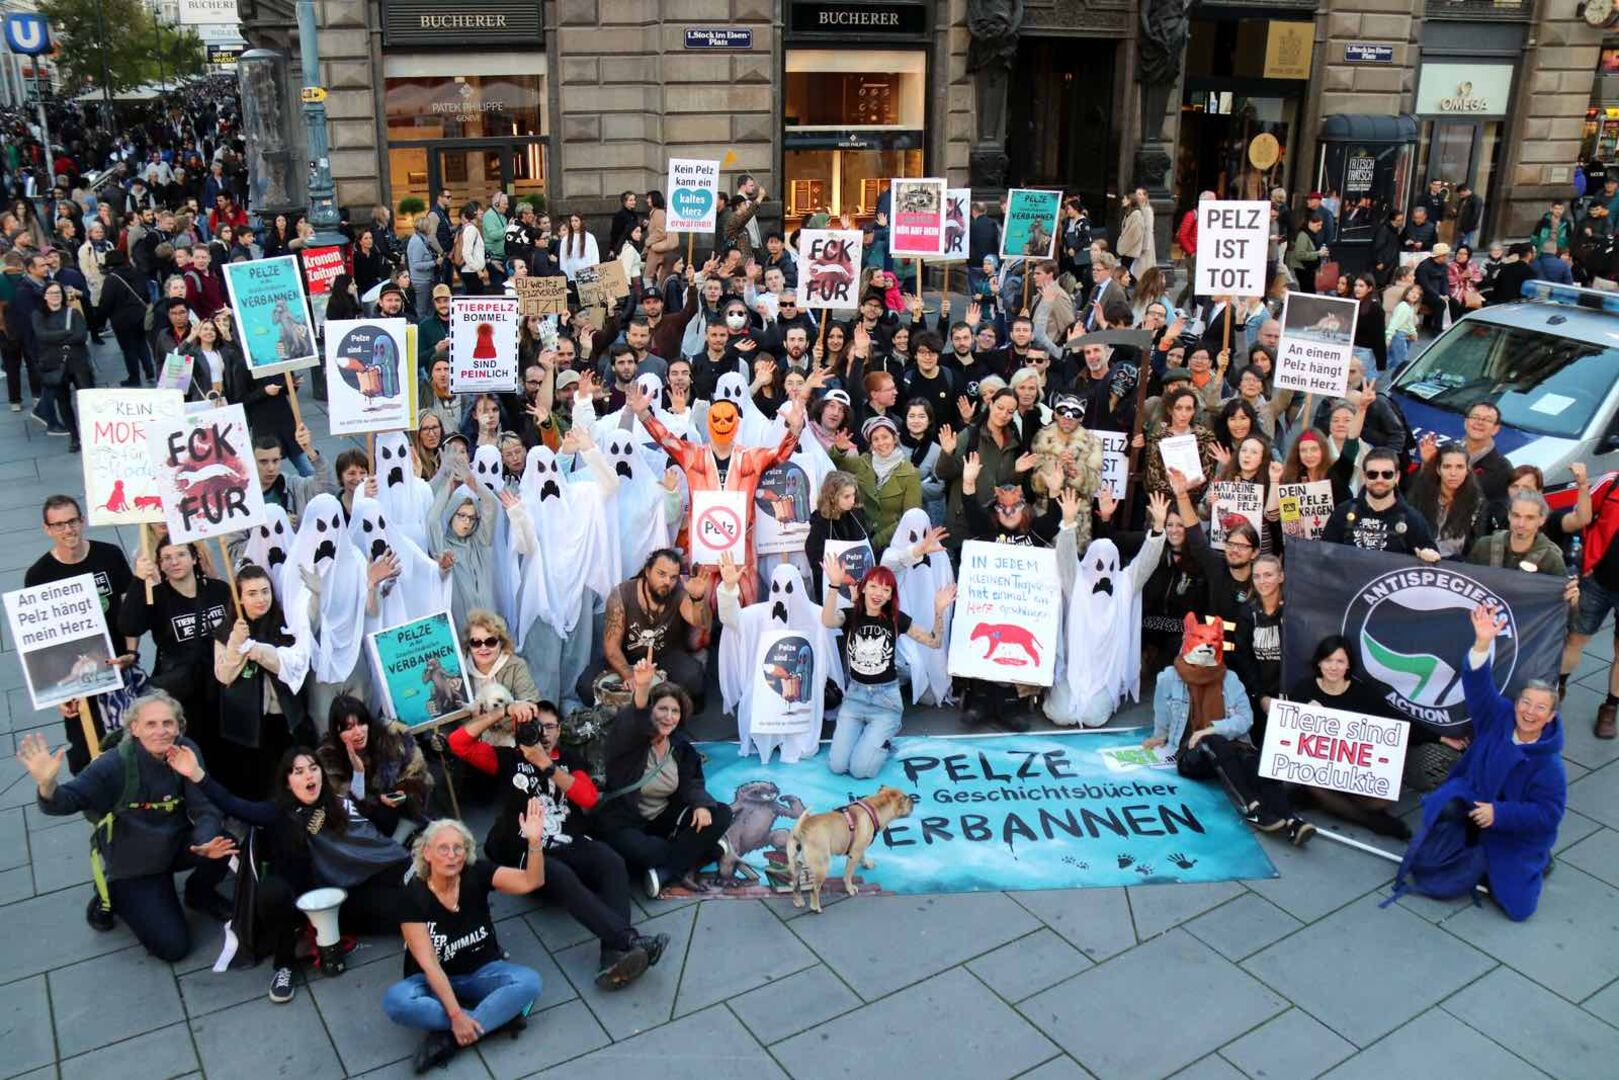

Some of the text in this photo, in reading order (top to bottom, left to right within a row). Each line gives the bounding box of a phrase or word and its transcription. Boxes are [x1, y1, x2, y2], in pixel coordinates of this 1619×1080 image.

[420, 14, 507, 28] BUCHERER
[819, 11, 899, 25] BUCHERER
[10, 20, 40, 49] U
[432, 103, 460, 113] PATEK
[1441, 99, 1488, 111] OMEGA
[674, 165, 714, 175] Kein Pelz
[675, 177, 711, 187] kann ein
[679, 194, 705, 204] kaltes
[681, 206, 702, 216] Herz
[1207, 209, 1260, 229] PELZ
[670, 219, 712, 228] erwärmen
[811, 238, 854, 261] FCK
[1216, 239, 1250, 259] IST
[303, 251, 341, 269] Kronen
[249, 265, 280, 279] PELZE
[1207, 268, 1252, 288] TOT.
[241, 290, 300, 308] VERBANNEN
[806, 279, 849, 302] FUR
[457, 303, 514, 312] TIERPELZ
[463, 313, 508, 322] BOMMEL
[1288, 343, 1341, 361] An einem
[461, 370, 509, 378] PEINLICH
[473, 361, 497, 369] SIND
[1283, 358, 1342, 378] Pelz hängt
[1280, 374, 1341, 391] mein Herz.
[116, 402, 153, 416] KEIN
[167, 423, 237, 467] FCK
[1103, 438, 1125, 453] ELZ
[1103, 459, 1119, 473] ST
[1231, 484, 1255, 493] DEINE
[1279, 486, 1307, 498] DEIN
[179, 486, 250, 532] FUR
[1299, 505, 1333, 517] KRAGEN
[845, 553, 862, 561] Pelze
[972, 555, 1038, 573] IN JEDEM
[18, 592, 37, 608] An
[40, 582, 83, 601] einem
[968, 586, 989, 600] hat
[18, 597, 93, 627] Pelz hängt
[22, 618, 98, 645] mein Herz.
[397, 623, 433, 643] PELZE
[778, 643, 796, 651] Pelze
[388, 645, 454, 674] VERBANNEN
[1384, 691, 1451, 723] ACTION
[1276, 703, 1402, 747] Tiere sind
[1297, 732, 1374, 768] KEINE
[899, 749, 1079, 787] PELZE
[1271, 753, 1390, 797] Produkte
[933, 780, 1178, 803] Geschichtsbücher
[882, 803, 1206, 852] ERBANNEN
[444, 926, 488, 956] ANIMALS.
